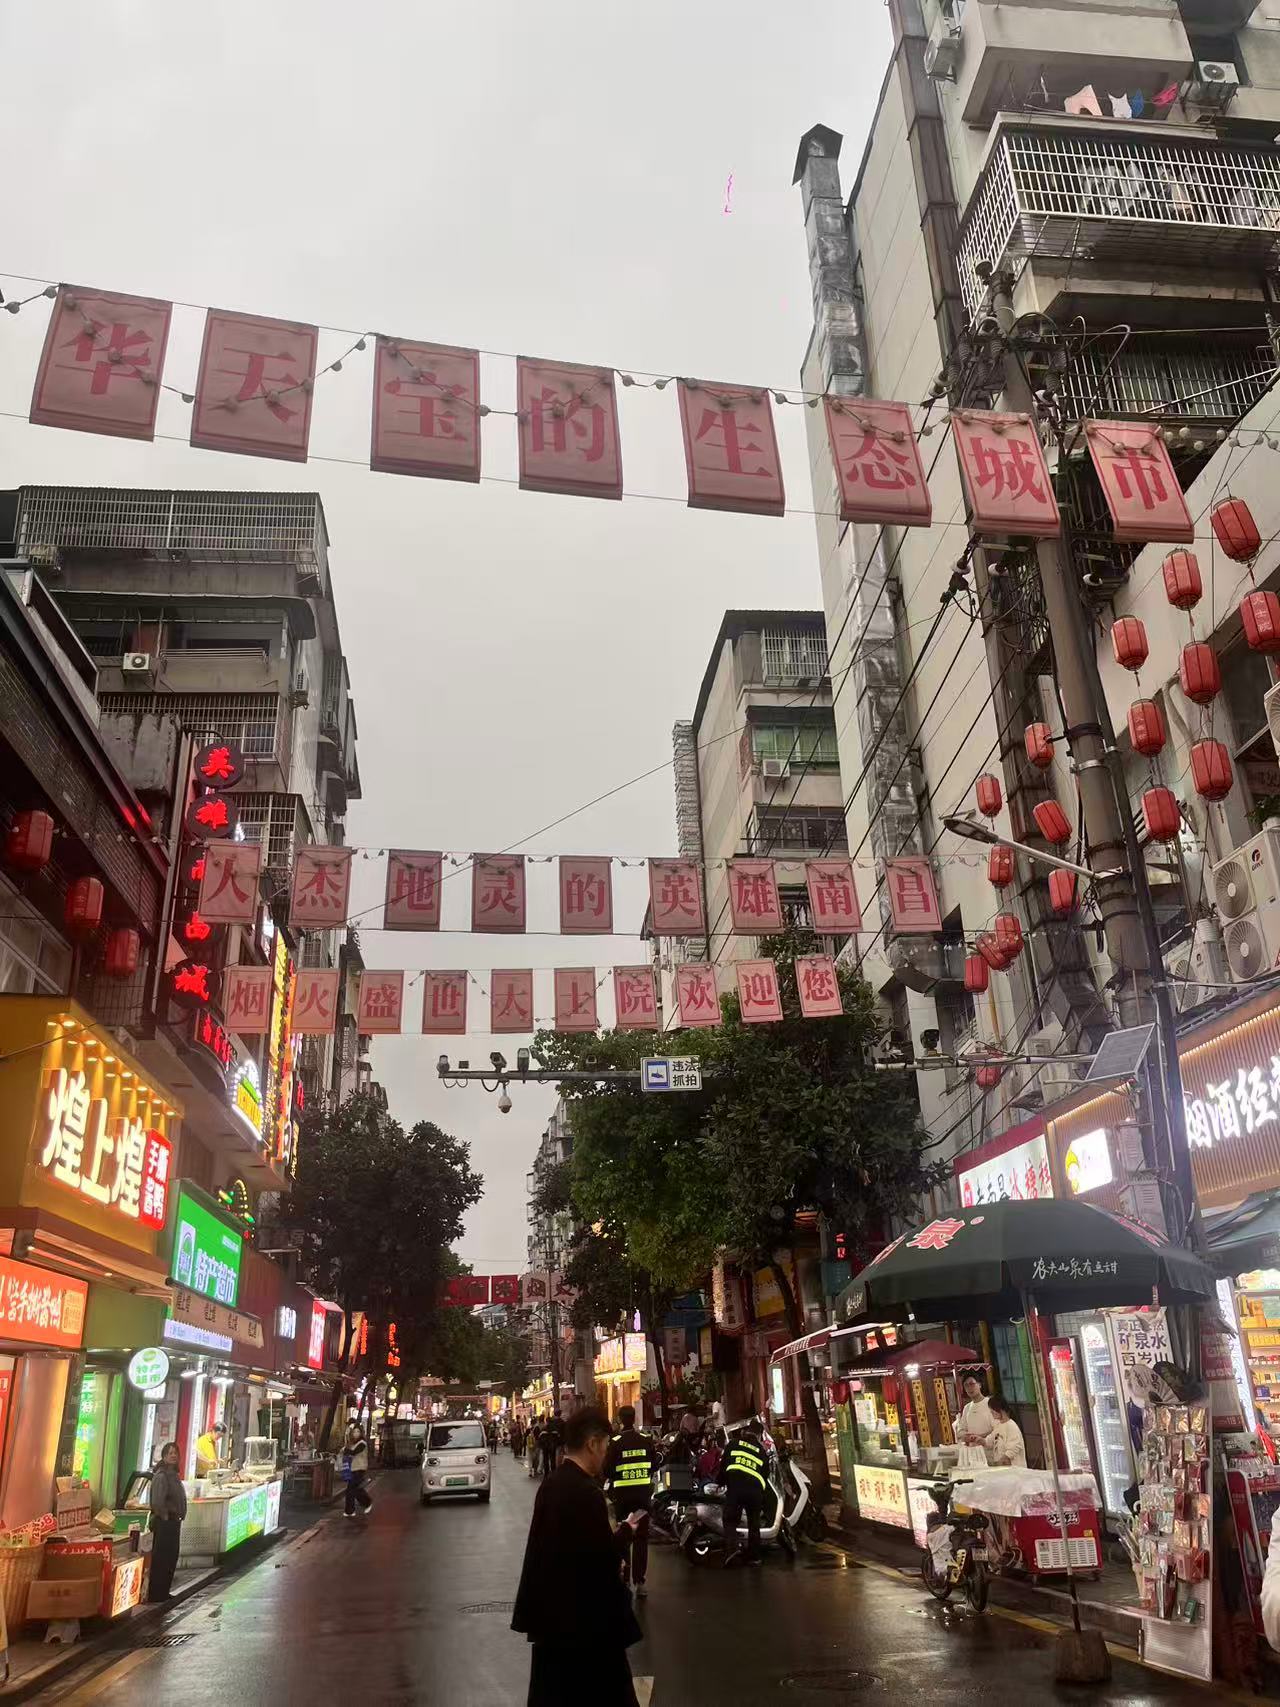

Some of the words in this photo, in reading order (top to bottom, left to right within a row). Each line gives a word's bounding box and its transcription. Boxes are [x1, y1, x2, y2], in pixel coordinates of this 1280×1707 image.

[672, 1060, 697, 1072] 违法
[672, 1074, 697, 1086] 抓拍
[42, 1067, 147, 1218] 煌上煌
[1032, 1257, 1118, 1279] 农夫山泉有点甜
[1118, 1332, 1167, 1350] 矿泉水
[622, 1469, 648, 1479] 综合执法
